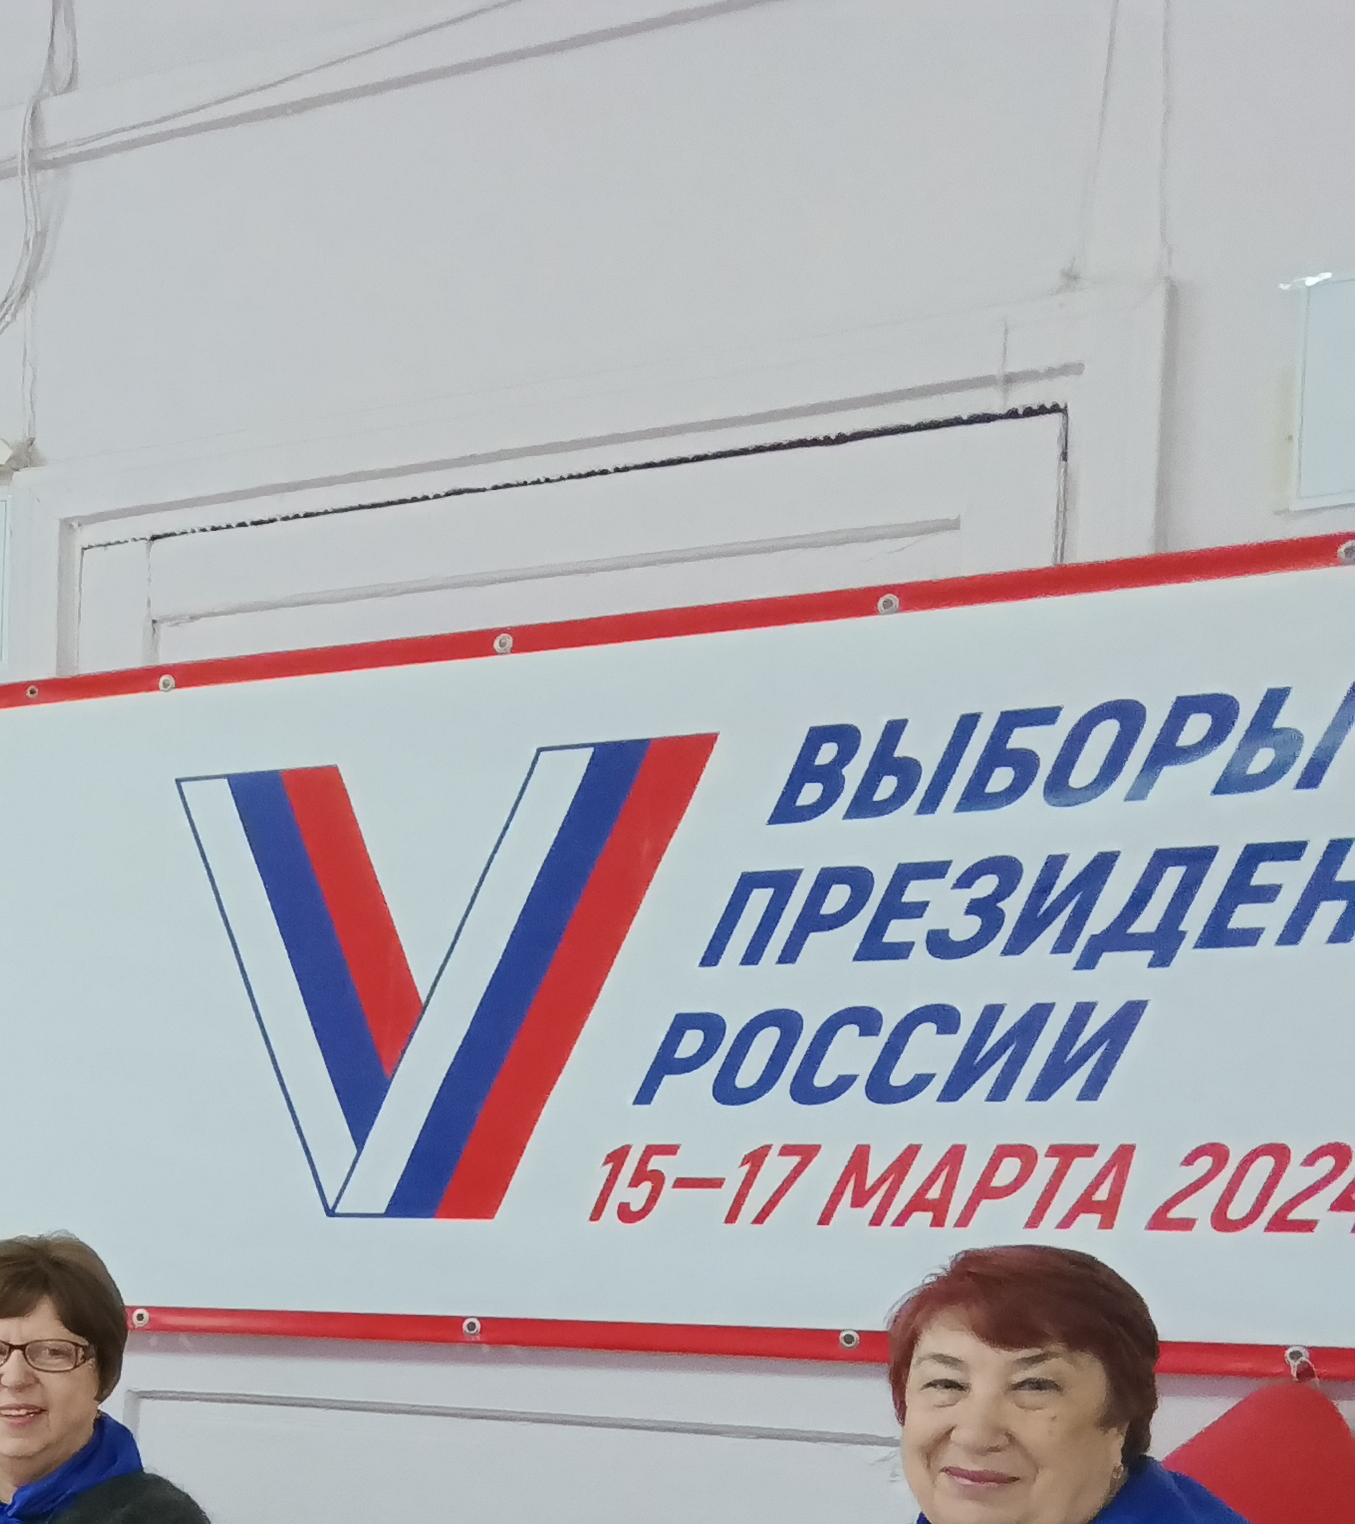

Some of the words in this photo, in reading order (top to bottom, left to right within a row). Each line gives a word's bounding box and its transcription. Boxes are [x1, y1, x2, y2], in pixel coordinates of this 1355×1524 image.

[632, 998, 1149, 1107] РОССИИ
[589, 1141, 821, 1225] 15–17
[817, 1141, 1137, 1231] МАРТА
